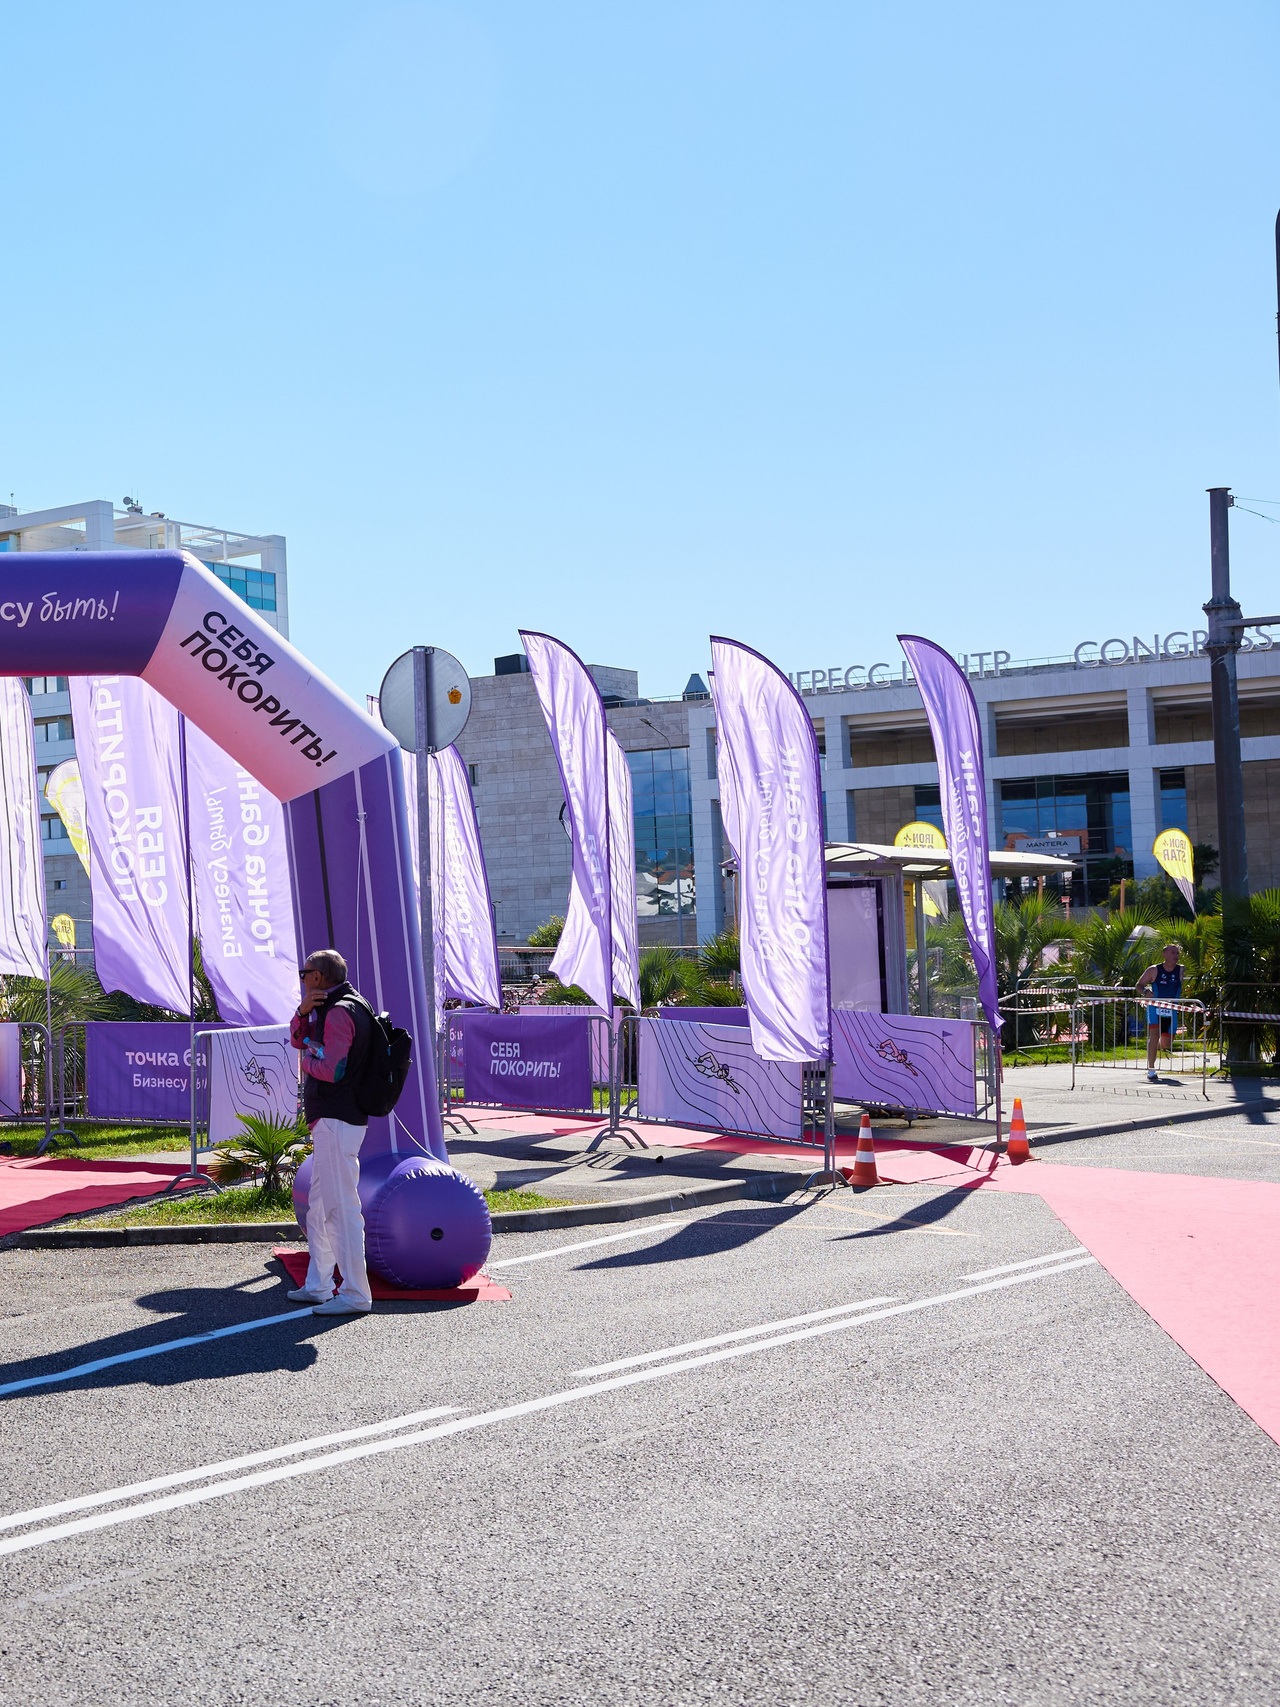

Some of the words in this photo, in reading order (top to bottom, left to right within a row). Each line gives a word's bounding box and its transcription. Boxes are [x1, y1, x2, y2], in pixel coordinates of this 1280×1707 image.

[39, 590, 120, 622] быть!
[202, 610, 276, 676] СЕБЯ
[1074, 625, 1273, 668] CONGRSS
[789, 661, 890, 695] ГРЕСС
[179, 629, 338, 768] ПОКОРИТЬ!
[1026, 840, 1069, 848] MANTERA
[125, 1051, 179, 1067] точка
[183, 1048, 207, 1067] ба
[490, 1041, 520, 1058] СЕБЯ
[490, 1059, 562, 1078] ПОКОРИТЬ!
[133, 1073, 188, 1092] Бизнесу
